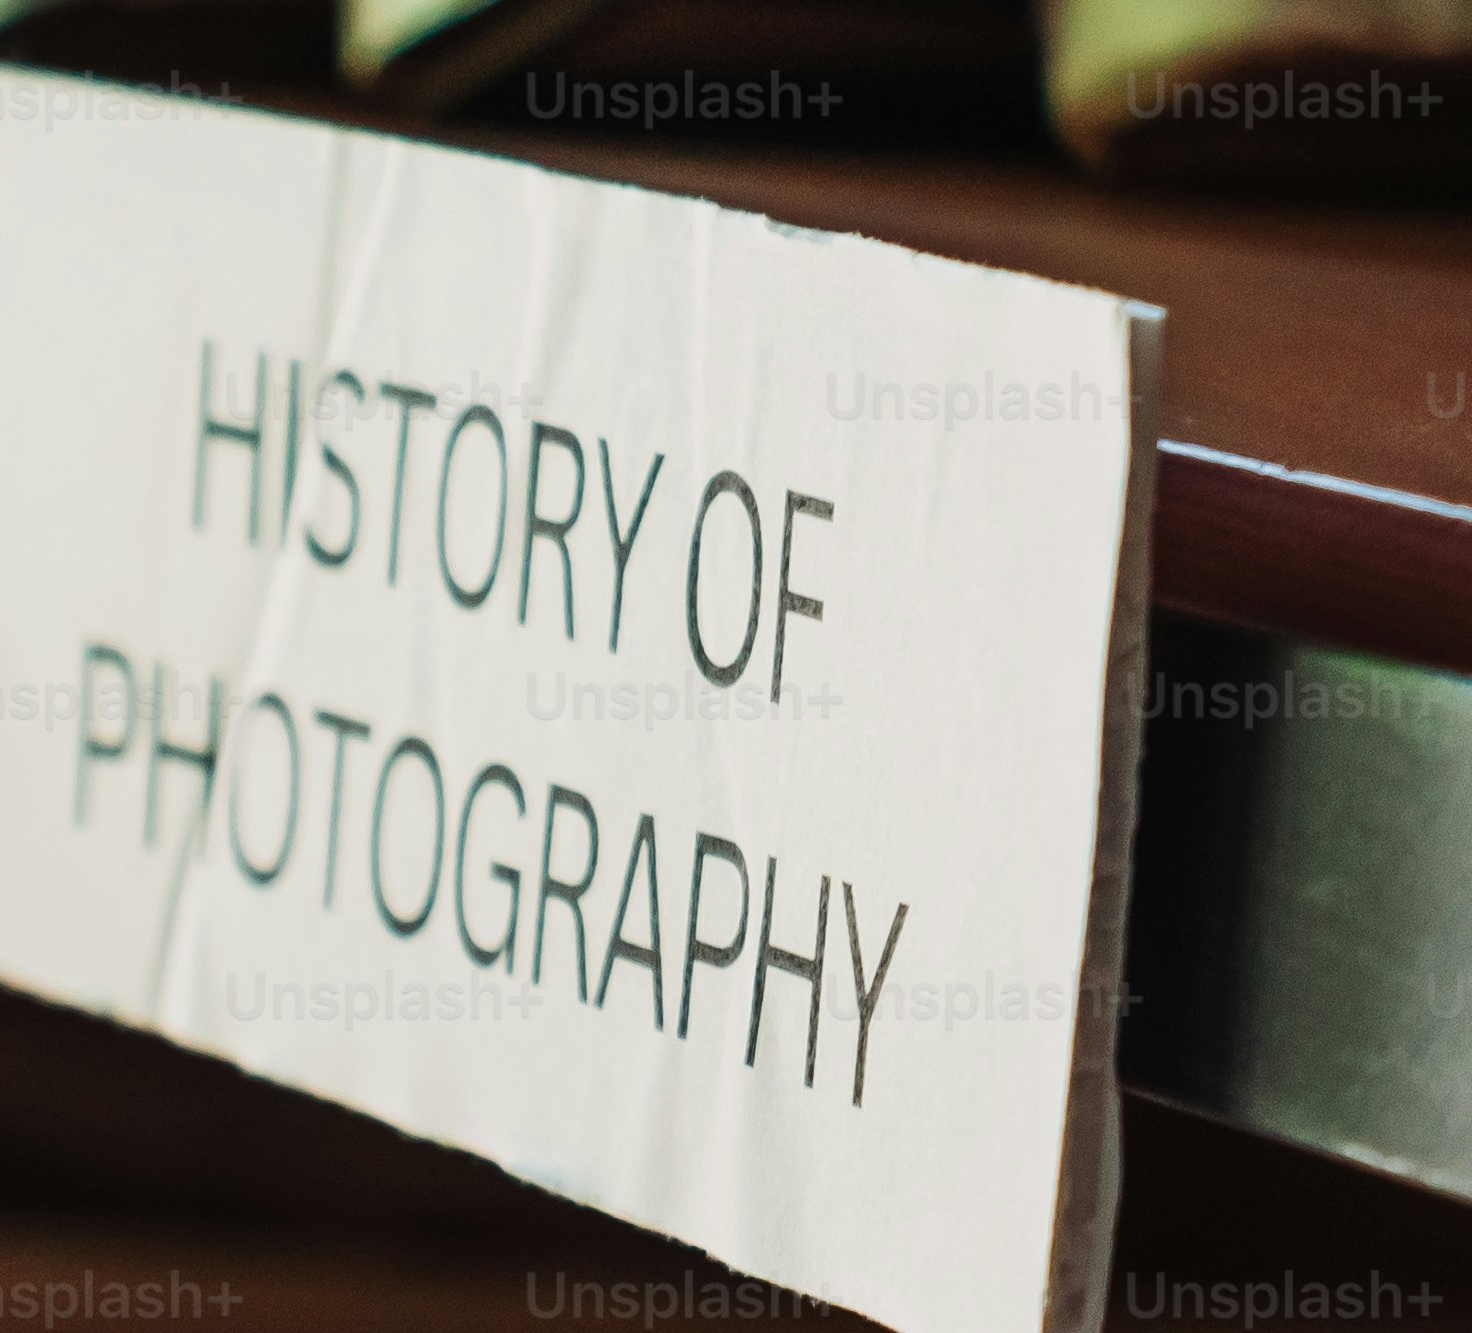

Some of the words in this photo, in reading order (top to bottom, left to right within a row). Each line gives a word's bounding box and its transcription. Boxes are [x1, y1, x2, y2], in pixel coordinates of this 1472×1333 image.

[192, 338, 665, 653] HISTORY
[686, 469, 834, 704] OF
[73, 643, 910, 1108] PHOTOGRAPHY
